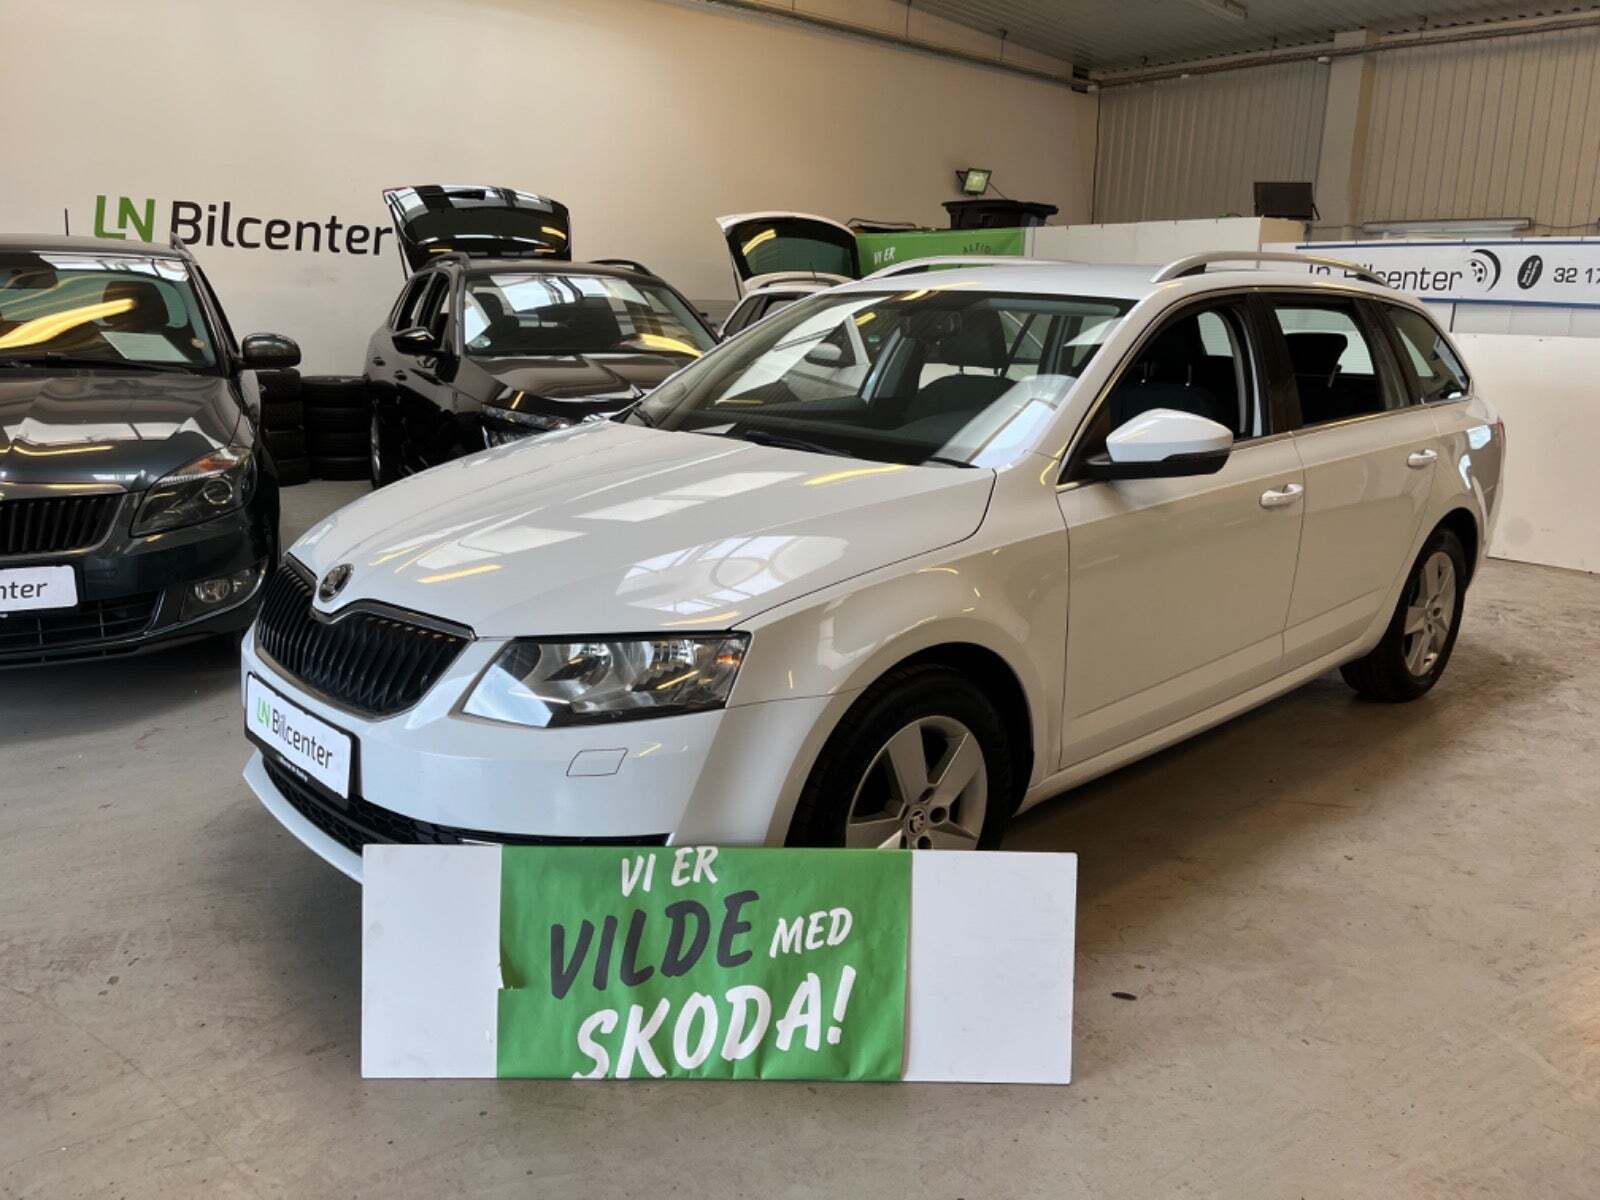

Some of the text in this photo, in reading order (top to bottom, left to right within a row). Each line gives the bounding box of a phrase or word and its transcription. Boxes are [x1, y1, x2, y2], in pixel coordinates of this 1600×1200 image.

[94, 195, 393, 256] LN Bilcenter
[1553, 267, 1578, 284] 32
[272, 707, 333, 769] Bilcenter
[621, 846, 718, 897] VI ER
[550, 890, 853, 1000] VILDE MED
[571, 965, 857, 1080] SKODA!
